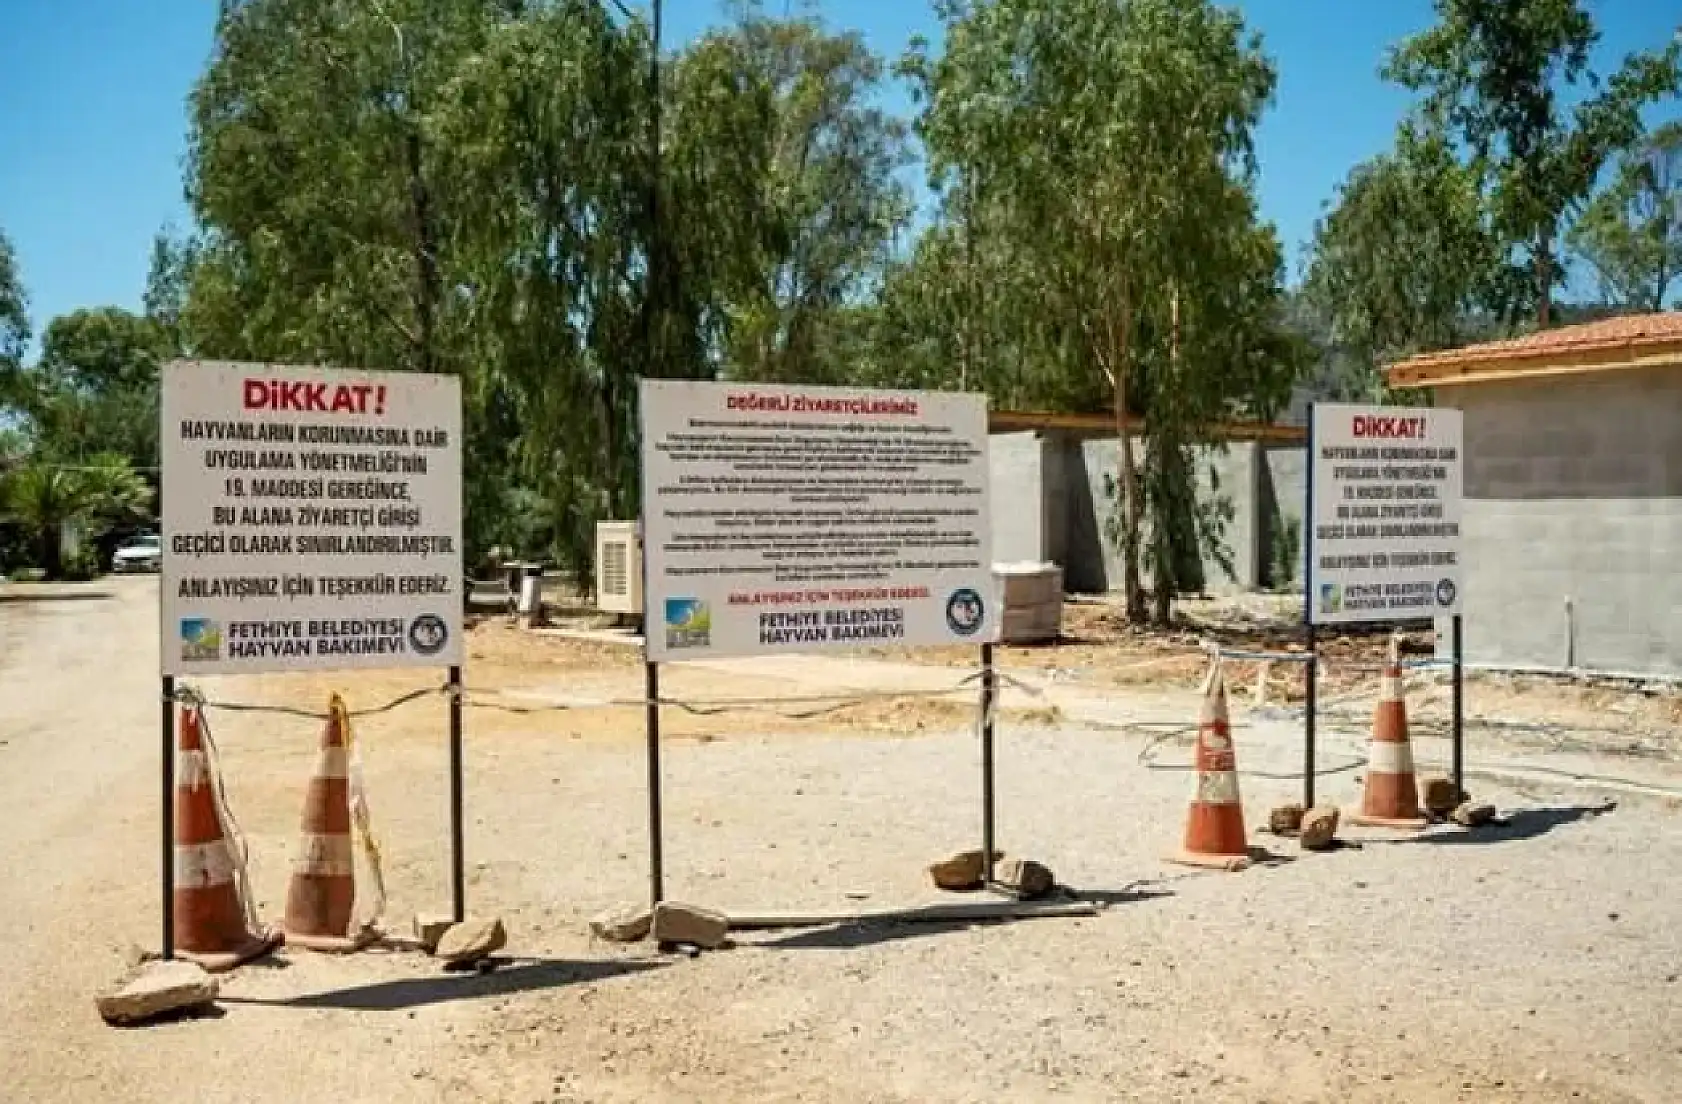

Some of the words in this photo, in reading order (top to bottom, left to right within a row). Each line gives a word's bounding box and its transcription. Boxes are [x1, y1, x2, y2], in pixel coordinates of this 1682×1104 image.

[181, 421, 294, 443] HAYVANLARIN
[299, 423, 408, 446] KORUNMASINA
[415, 426, 448, 447] DAİR
[205, 450, 294, 469] UYGULAMA
[225, 479, 245, 496] 19.
[251, 477, 322, 497] MADDESİ
[213, 507, 235, 525] BU
[240, 507, 293, 525] ALANA
[298, 504, 373, 530] ZİYARETÇİ
[172, 531, 224, 556] GEÇİCİ
[229, 535, 292, 553] OLARAK
[179, 577, 277, 600] ANLAYIŞINIZ
[283, 573, 313, 600] İÇİN
[319, 573, 395, 599] TEŞEKKÜR
[760, 627, 826, 644] HAYVAN
[228, 639, 310, 657] HAYVAN
